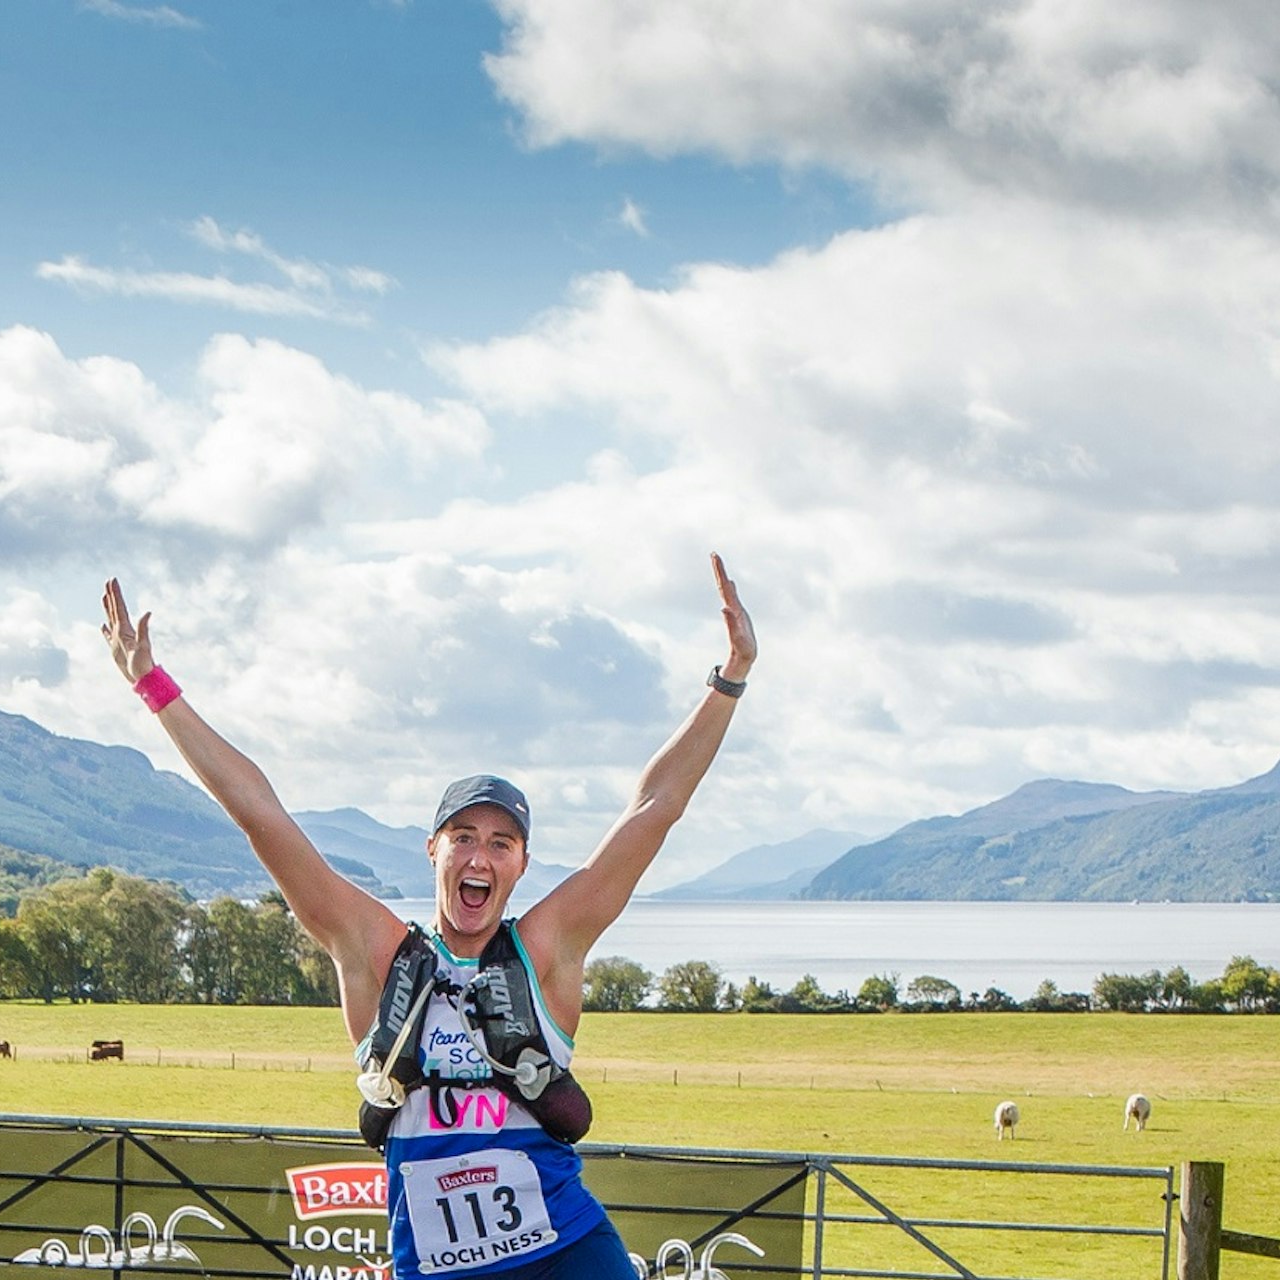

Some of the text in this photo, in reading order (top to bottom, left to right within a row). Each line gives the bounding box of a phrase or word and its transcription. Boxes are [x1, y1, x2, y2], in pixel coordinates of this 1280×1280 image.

[302, 1174, 388, 1209] Baxt
[440, 1171, 495, 1190] Baxters
[436, 1186, 522, 1243] 113
[288, 1225, 376, 1254] LOCH
[431, 1228, 543, 1268] LOCH NESS
